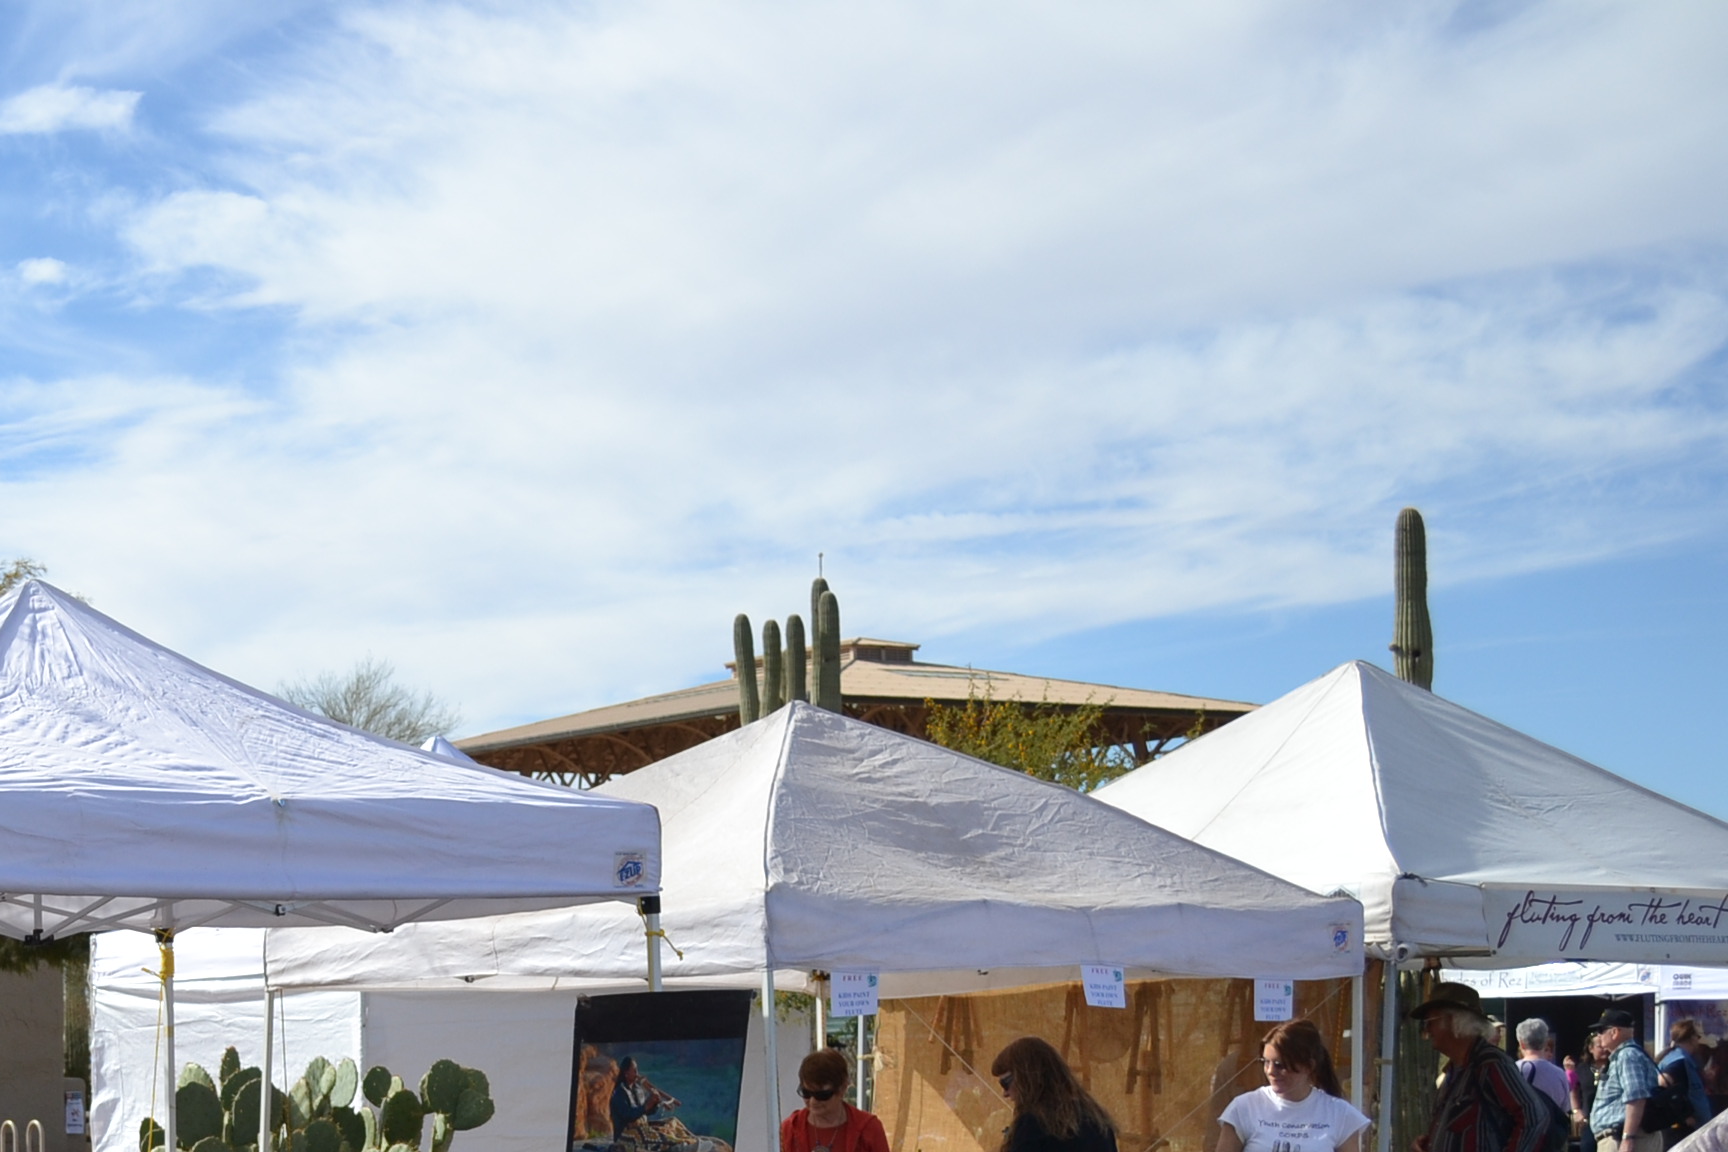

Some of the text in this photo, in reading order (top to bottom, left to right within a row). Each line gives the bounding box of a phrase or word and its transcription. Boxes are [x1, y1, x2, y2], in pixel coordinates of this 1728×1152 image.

[1497, 890, 1728, 951] fluting from the heart
[842, 974, 862, 982] FREE
